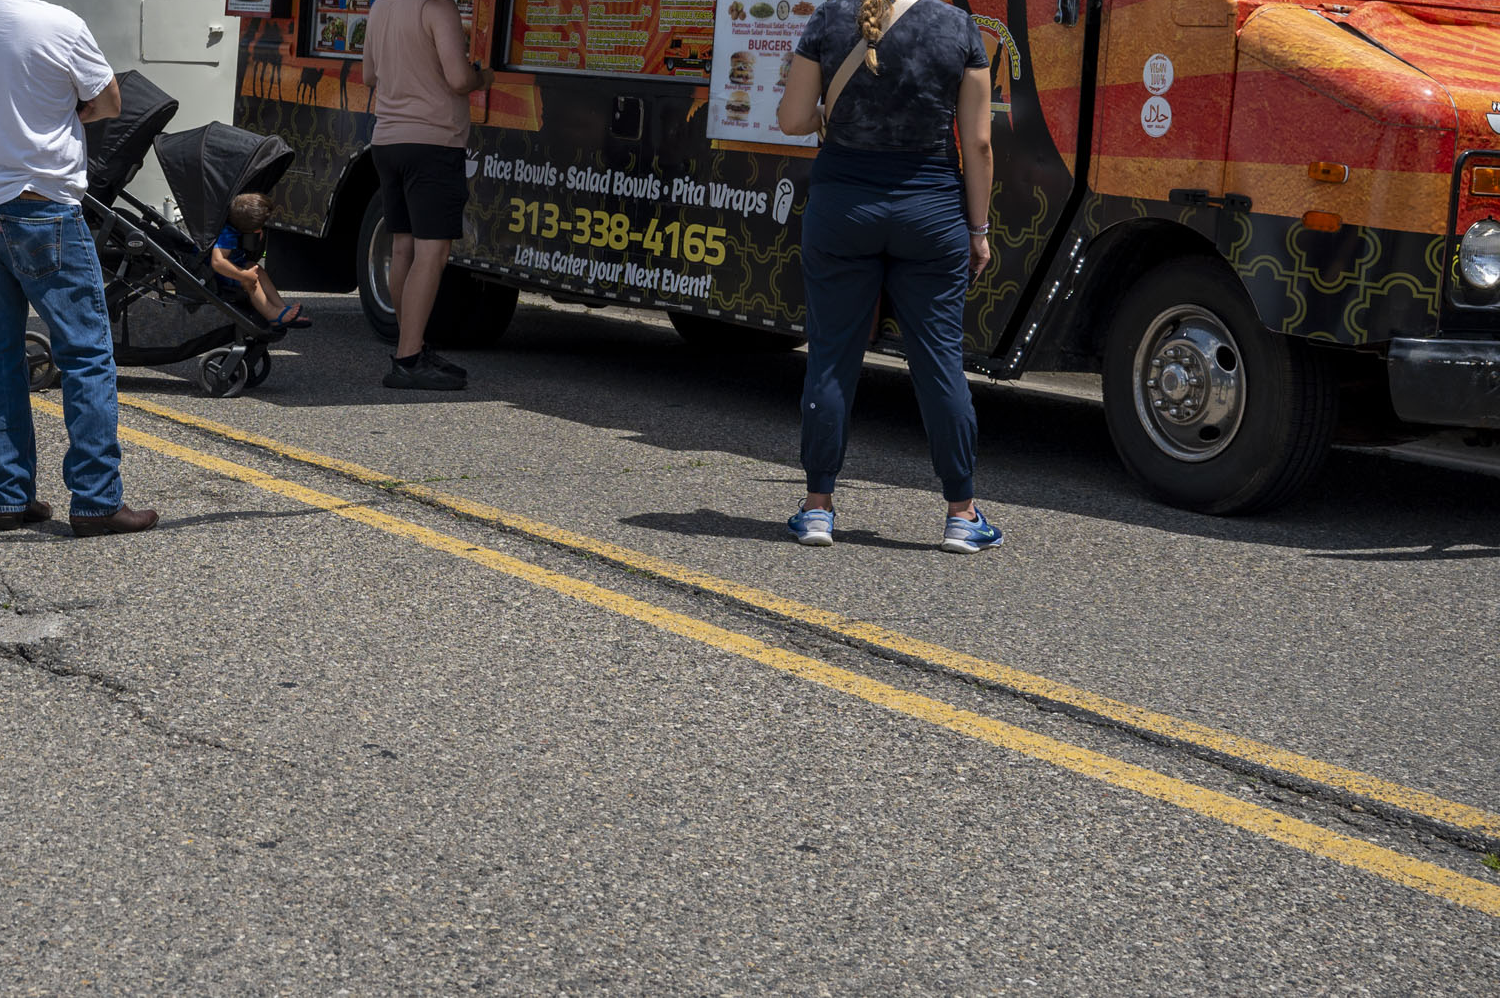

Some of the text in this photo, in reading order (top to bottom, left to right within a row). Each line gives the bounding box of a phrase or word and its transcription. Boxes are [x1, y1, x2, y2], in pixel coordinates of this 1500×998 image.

[748, 39, 792, 52] BURGERS
[1150, 63, 1166, 73] VEGAN
[1150, 74, 1166, 85] 100%
[1145, 104, 1168, 122] حلال
[484, 155, 767, 217] Rice Bowls Salad Bowls Pita Wraps
[508, 197, 727, 266] 313-338-4165
[514, 244, 711, 299] Let us Cater your Next Event!
